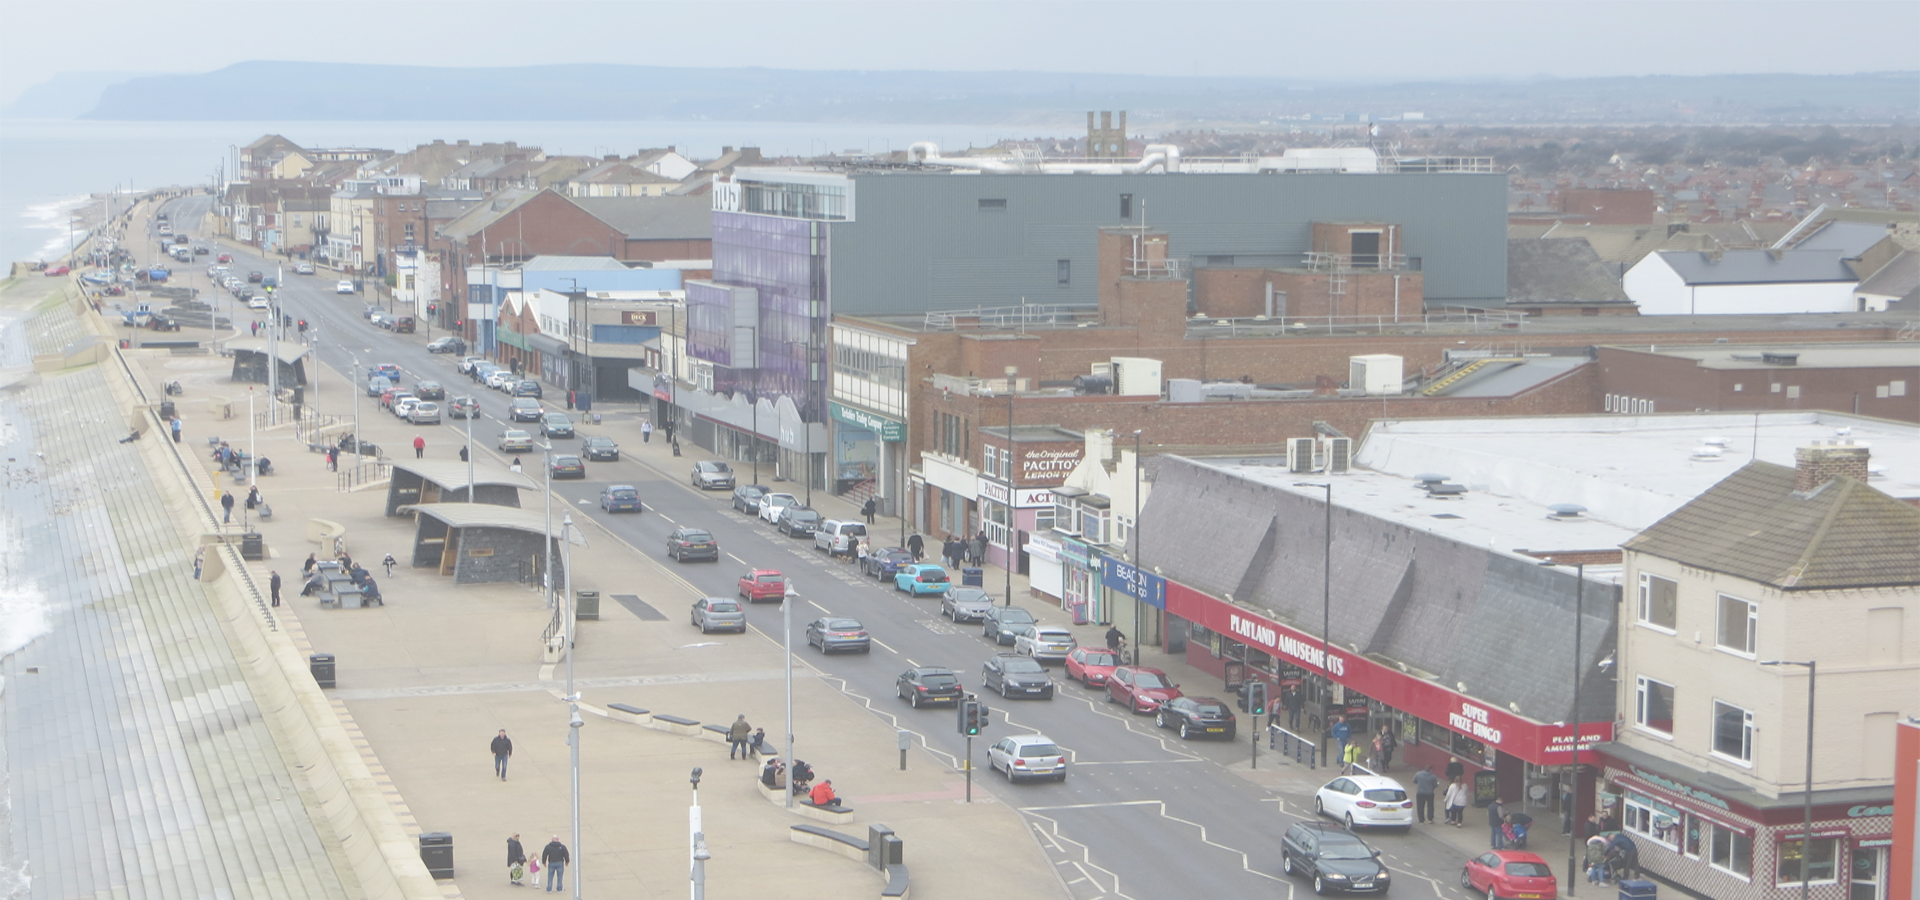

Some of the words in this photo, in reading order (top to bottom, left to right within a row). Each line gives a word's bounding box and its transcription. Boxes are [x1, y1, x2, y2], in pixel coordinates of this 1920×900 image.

[841, 406, 856, 421] Yorkshire
[1025, 450, 1040, 459] the
[1040, 449, 1079, 461] Original
[1025, 471, 1060, 479] LEMON
[1230, 614, 1275, 648] PLAYLAND
[1462, 703, 1488, 724] SUPER
[1450, 712, 1472, 732] PRIZE
[1473, 722, 1501, 744] BINGO
